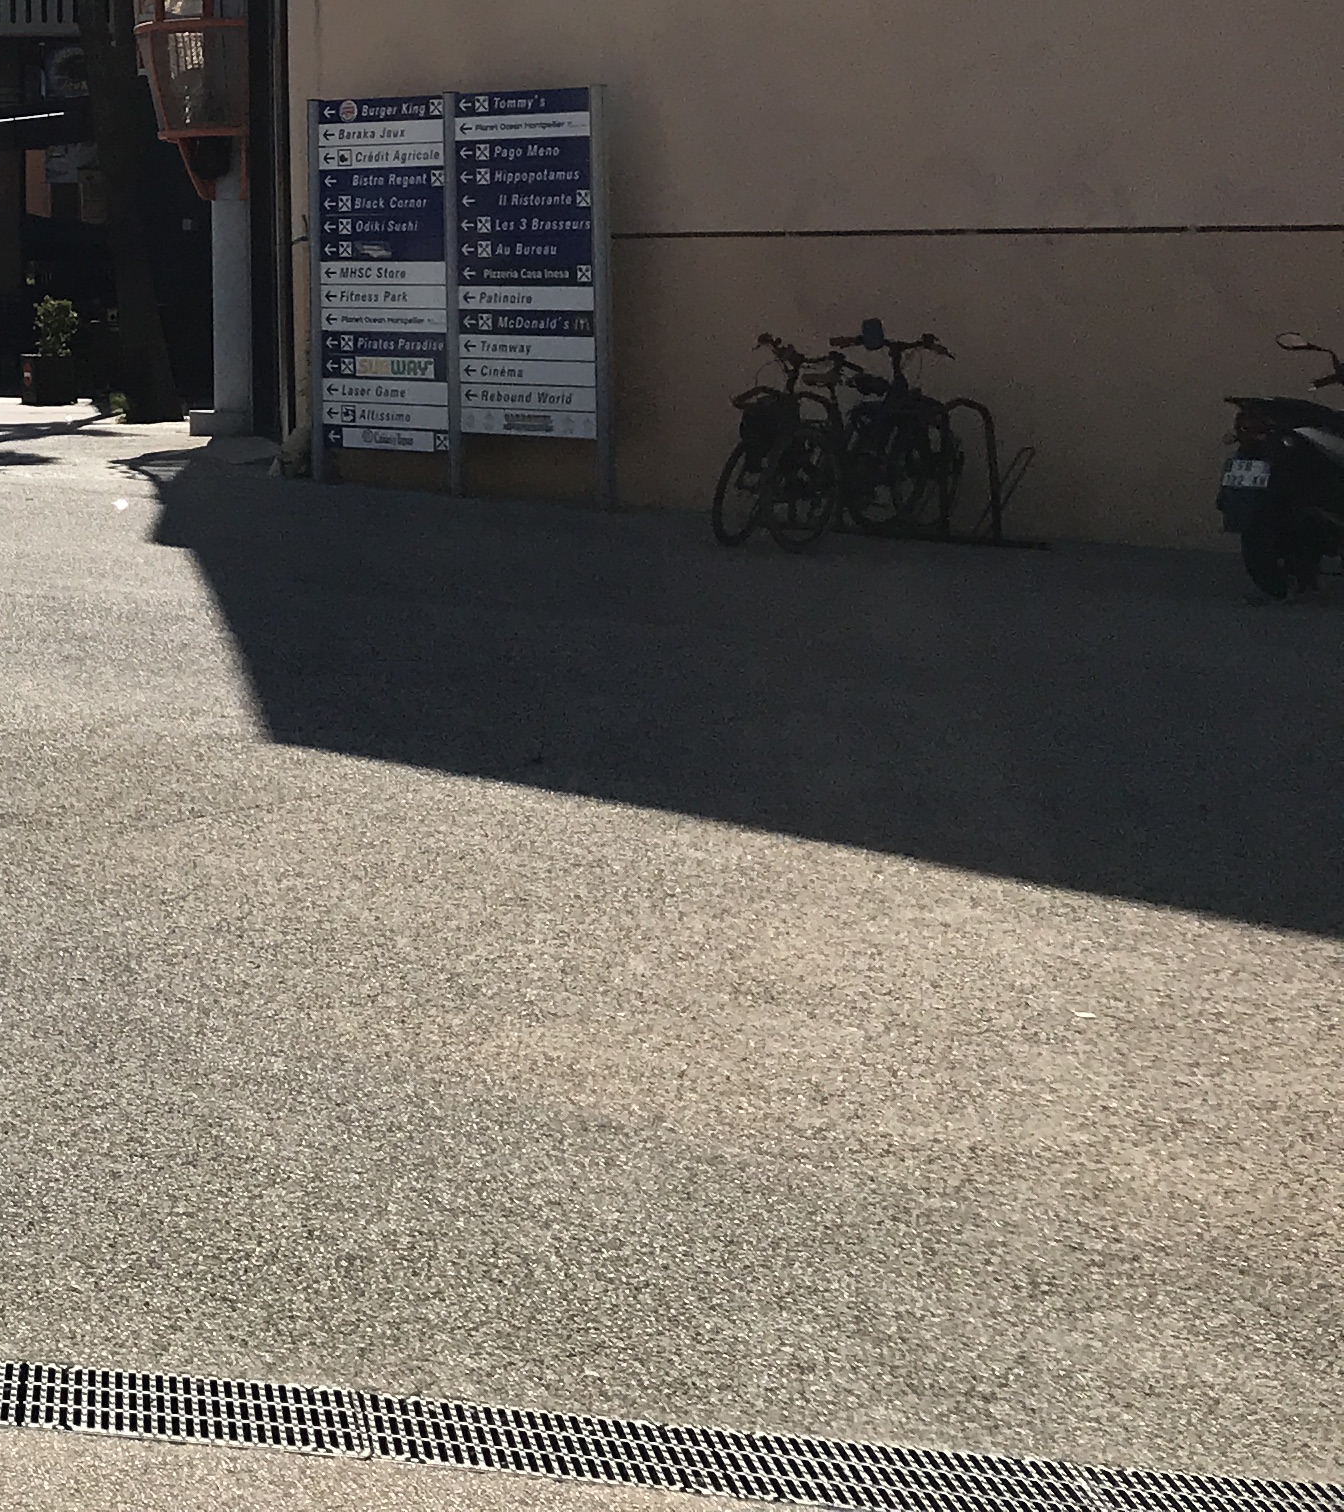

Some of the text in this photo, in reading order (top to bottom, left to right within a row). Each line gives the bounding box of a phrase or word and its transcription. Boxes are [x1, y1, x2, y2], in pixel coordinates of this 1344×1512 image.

[493, 95, 545, 110] Tommy's
[361, 105, 397, 119] Burger
[401, 103, 426, 116] King
[338, 129, 375, 139] Baraka
[355, 150, 440, 164] Crédit Agricole
[494, 145, 560, 160] Pago Meno
[352, 174, 428, 188] Bistro Regent
[494, 169, 580, 184] Hippopotamus
[354, 197, 427, 209] Black Corner
[511, 194, 572, 206] Ristorante
[387, 220, 418, 231] Sushi
[496, 218, 590, 230] Les 3 Brasseurs
[495, 243, 557, 255] Au Bureau
[339, 267, 406, 278] MHSC Store
[484, 268, 519, 279] Pizzeria
[520, 269, 542, 279] Casa
[339, 291, 408, 302] Fitness Park
[479, 292, 533, 304] Patinoire
[498, 316, 569, 330] McDonald's
[357, 338, 444, 351] Pirates Paradise
[480, 340, 531, 355] Tramway
[480, 365, 524, 378] Cinéma
[342, 385, 406, 398] Laser Game
[481, 390, 572, 404] Rebound World
[359, 410, 411, 422] Altissimo
